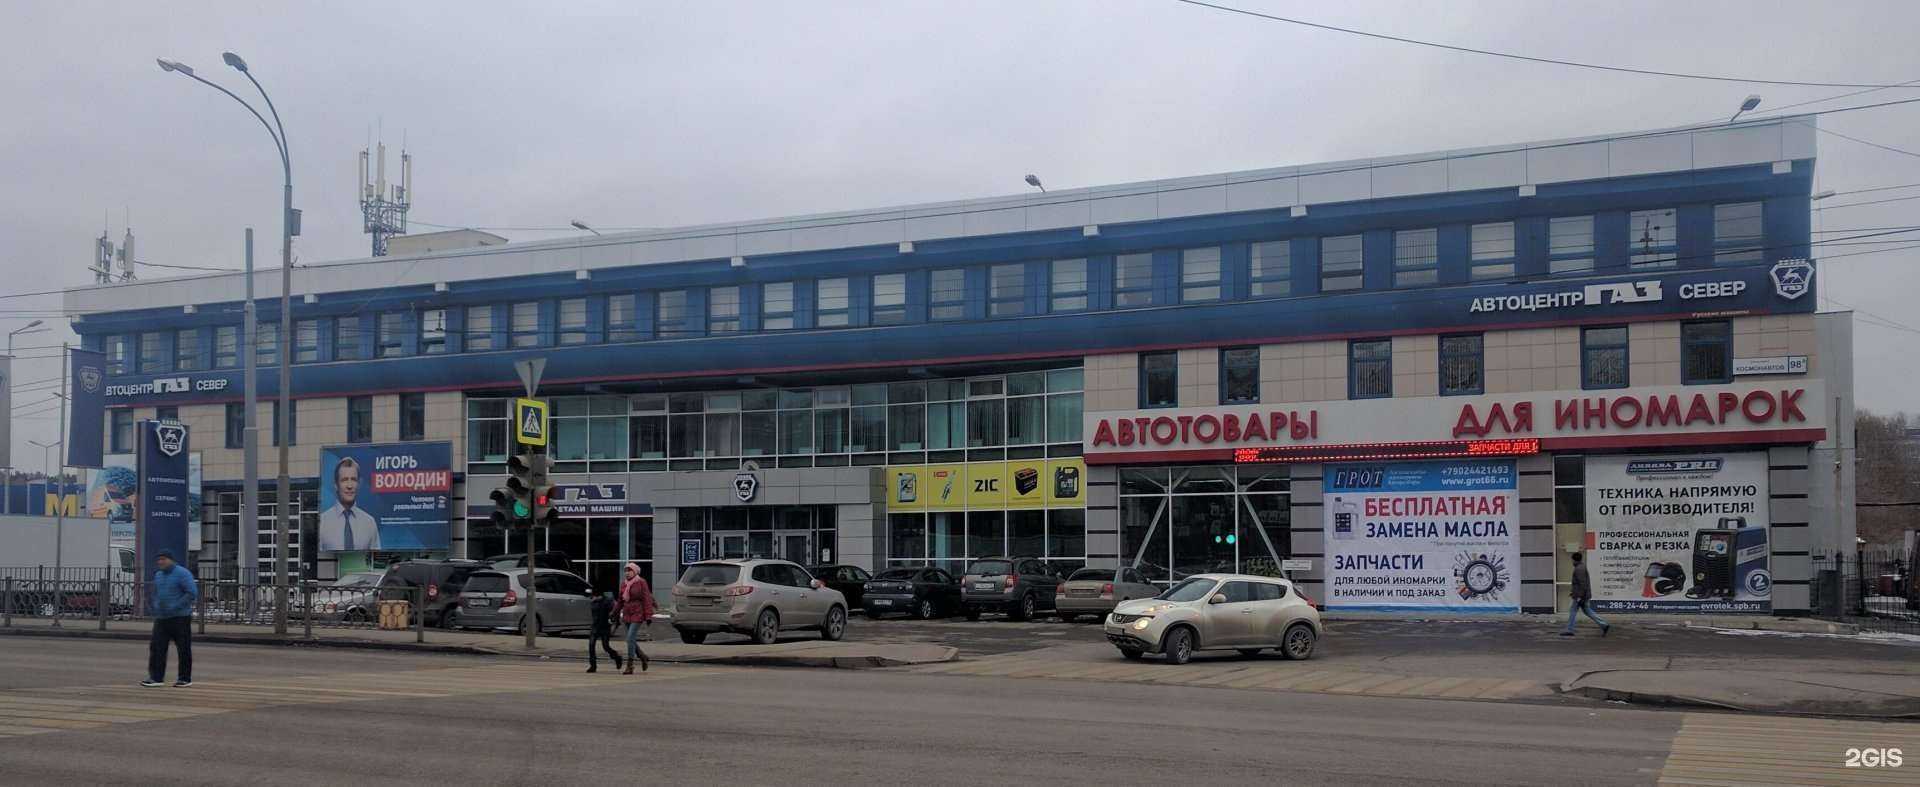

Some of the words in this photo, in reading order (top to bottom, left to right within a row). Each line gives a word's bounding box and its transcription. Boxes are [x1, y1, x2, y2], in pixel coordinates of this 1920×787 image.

[1470, 292, 1584, 313] АВТОЦЕНТР
[1584, 280, 1663, 305] ГАЗ
[1679, 280, 1746, 299] СЕВЕР
[105, 383, 153, 396] ВТОЦЕНТР
[153, 377, 190, 393] ГАЗ
[196, 379, 228, 391] СЕВЕР
[1092, 409, 1319, 447] АВТОТОВАРЫ
[1452, 401, 1533, 438] ДЛЯ
[1554, 388, 1806, 430] ИНОМАРОК
[1468, 443, 1511, 452] ЗАПЧАСТИ
[375, 455, 418, 469] ИГОРЬ
[375, 472, 447, 490] ВОЛОДИН
[1334, 468, 1385, 487] ГРОТ
[974, 479, 998, 492] ZIC
[1599, 487, 1664, 499] ТЕХНИКА
[1669, 485, 1757, 498] НАПРЯМУЮ
[1599, 505, 1617, 515] ОТ
[1622, 502, 1755, 516] ПРОИЗВОДИТЕЛЯ!
[1366, 522, 1439, 538] ЗАМЕНА
[1444, 521, 1509, 537] МАСЛА
[1599, 531, 1690, 539] ПРОФЕССИОНАЛЬНАЯ
[1600, 541, 1642, 550] СВАРКА
[1655, 541, 1690, 550] РЕЗКА
[1334, 554, 1424, 570] ЗАПЧАСТИ
[1334, 577, 1353, 586] ДЛЯ
[1356, 575, 1390, 585] ЛЮБОЙ
[1392, 576, 1446, 585] ИНОМАРКИ
[1342, 589, 1385, 597] НАЛИЧИИ
[1386, 589, 1393, 597] И
[1396, 589, 1415, 598] ПОД
[1417, 589, 1446, 597] ЗАКАЗ
[1701, 602, 1761, 610] evrotek.spb.ru
